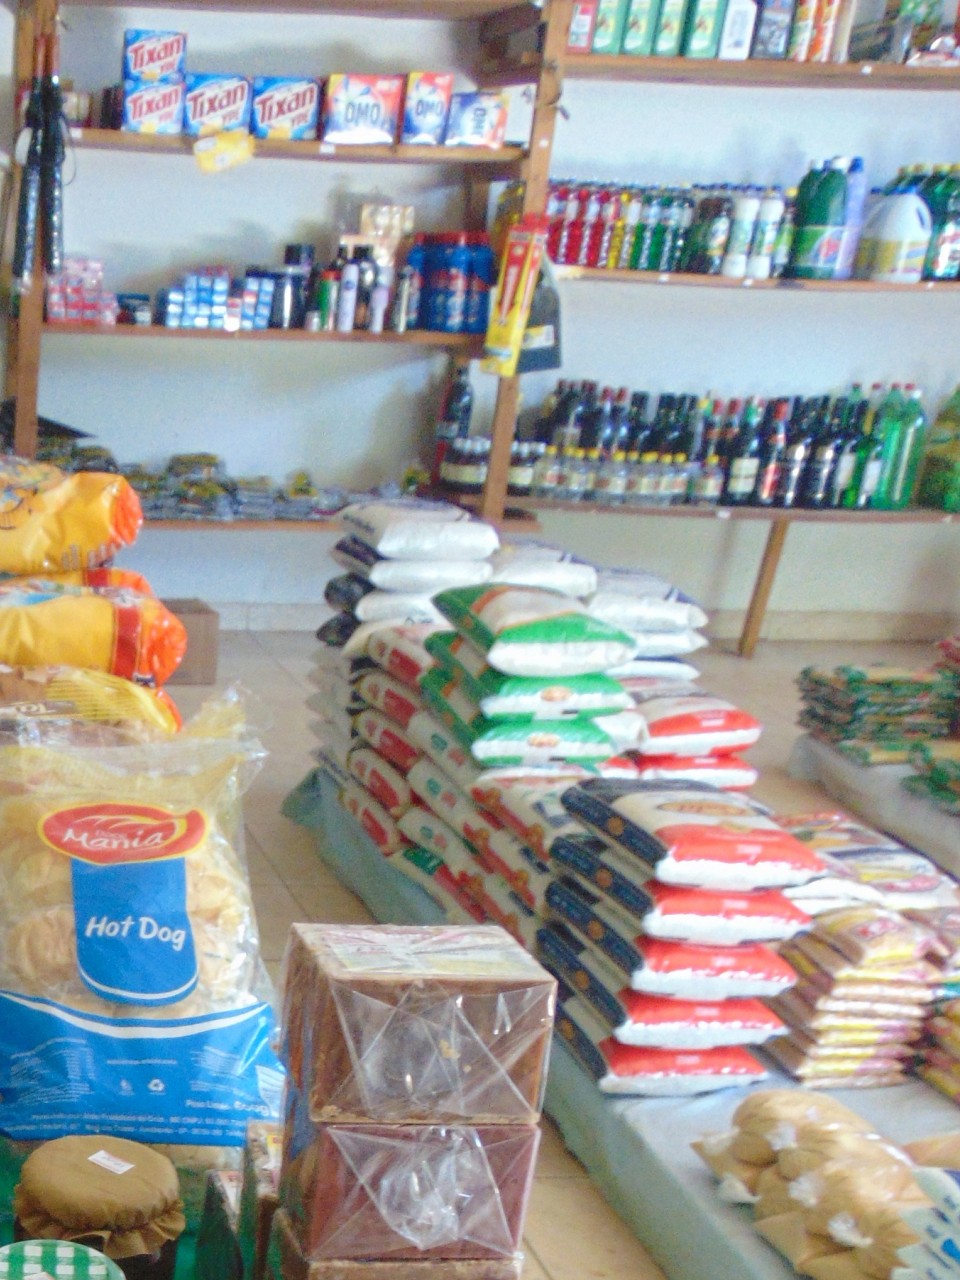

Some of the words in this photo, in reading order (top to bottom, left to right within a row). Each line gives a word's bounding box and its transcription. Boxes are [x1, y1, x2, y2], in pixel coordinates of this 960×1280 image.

[128, 34, 183, 71] Tixan
[128, 86, 182, 121] Tixan
[188, 82, 248, 122] Tixan
[256, 83, 318, 124] Tixan
[345, 101, 381, 126] OMO
[62, 827, 168, 852] Mania
[85, 916, 134, 939] Hot
[139, 917, 186, 951] Dog
